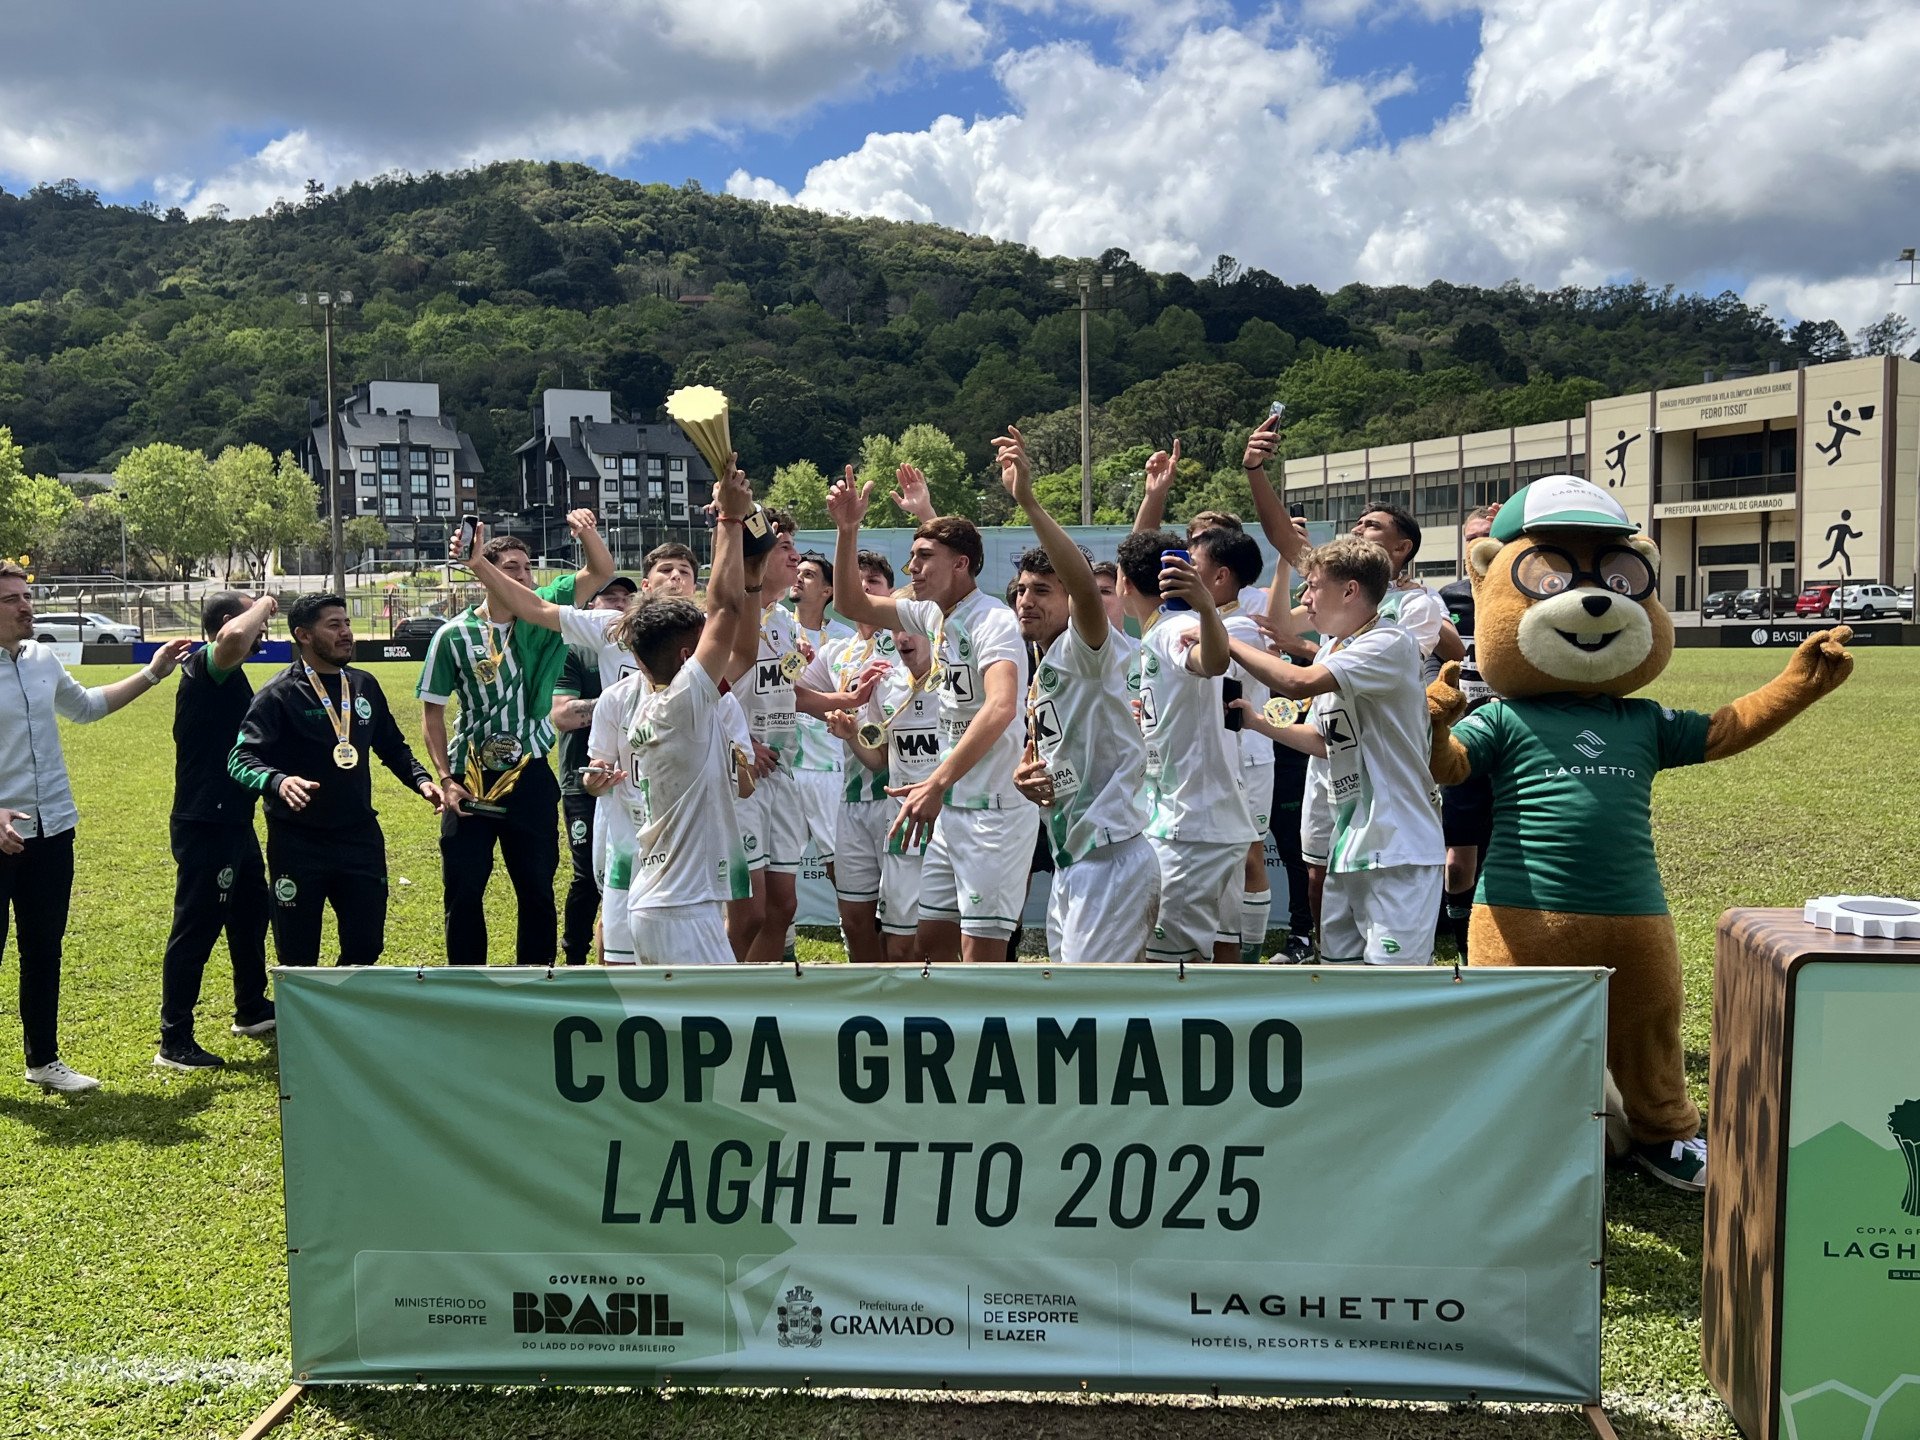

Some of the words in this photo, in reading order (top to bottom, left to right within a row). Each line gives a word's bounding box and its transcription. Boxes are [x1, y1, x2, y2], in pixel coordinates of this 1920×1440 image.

[1678, 395, 1711, 406] POLIESPORTIVO
[1719, 391, 1730, 400] VILA
[1772, 382, 1792, 393] GRANDE
[1700, 406, 1723, 420] PEDRO
[1724, 403, 1748, 417] TISSOT
[1664, 503, 1701, 515] PREFEITURA
[1702, 501, 1737, 513] MUNICIPAL
[1739, 501, 1748, 510] DE
[1749, 498, 1783, 509] GRAMADO
[1545, 765, 1635, 778] LAGHETTO
[553, 1015, 797, 1103] COPA
[837, 1015, 1303, 1108] GRAMADO
[601, 1139, 1023, 1228] LAGHETTO
[1054, 1143, 1265, 1231] 2025
[1856, 1227, 1897, 1235] COPA
[1823, 1241, 1916, 1260] LAGH
[549, 1275, 618, 1286] GOVERNO
[626, 1276, 646, 1286] DO
[394, 1296, 466, 1309] MINISTÉRIO
[468, 1299, 487, 1310] DO
[859, 1300, 908, 1312] Prefeitura
[910, 1301, 924, 1312] de
[983, 1293, 1077, 1307] SECRETARIA
[1190, 1292, 1466, 1323] LAGHETTO
[428, 1314, 488, 1326] ESPORTE
[512, 1291, 684, 1337] BRASIL
[984, 1311, 1004, 1323] DE
[1007, 1311, 1079, 1324] ESPORTE
[830, 1314, 955, 1336] GRAMADO
[984, 1329, 994, 1341] E
[996, 1329, 1046, 1342] LAZER
[522, 1341, 537, 1350] DO
[540, 1342, 567, 1351] LADO
[570, 1342, 585, 1351] DO
[588, 1343, 616, 1352] POVO
[619, 1343, 676, 1354] BRASILEIRO
[1191, 1335, 1252, 1350] HOTÉIS,
[1257, 1338, 1330, 1349] RESORTS
[1334, 1339, 1344, 1349] &
[1349, 1338, 1465, 1352] EXPERIÊNCIAS
